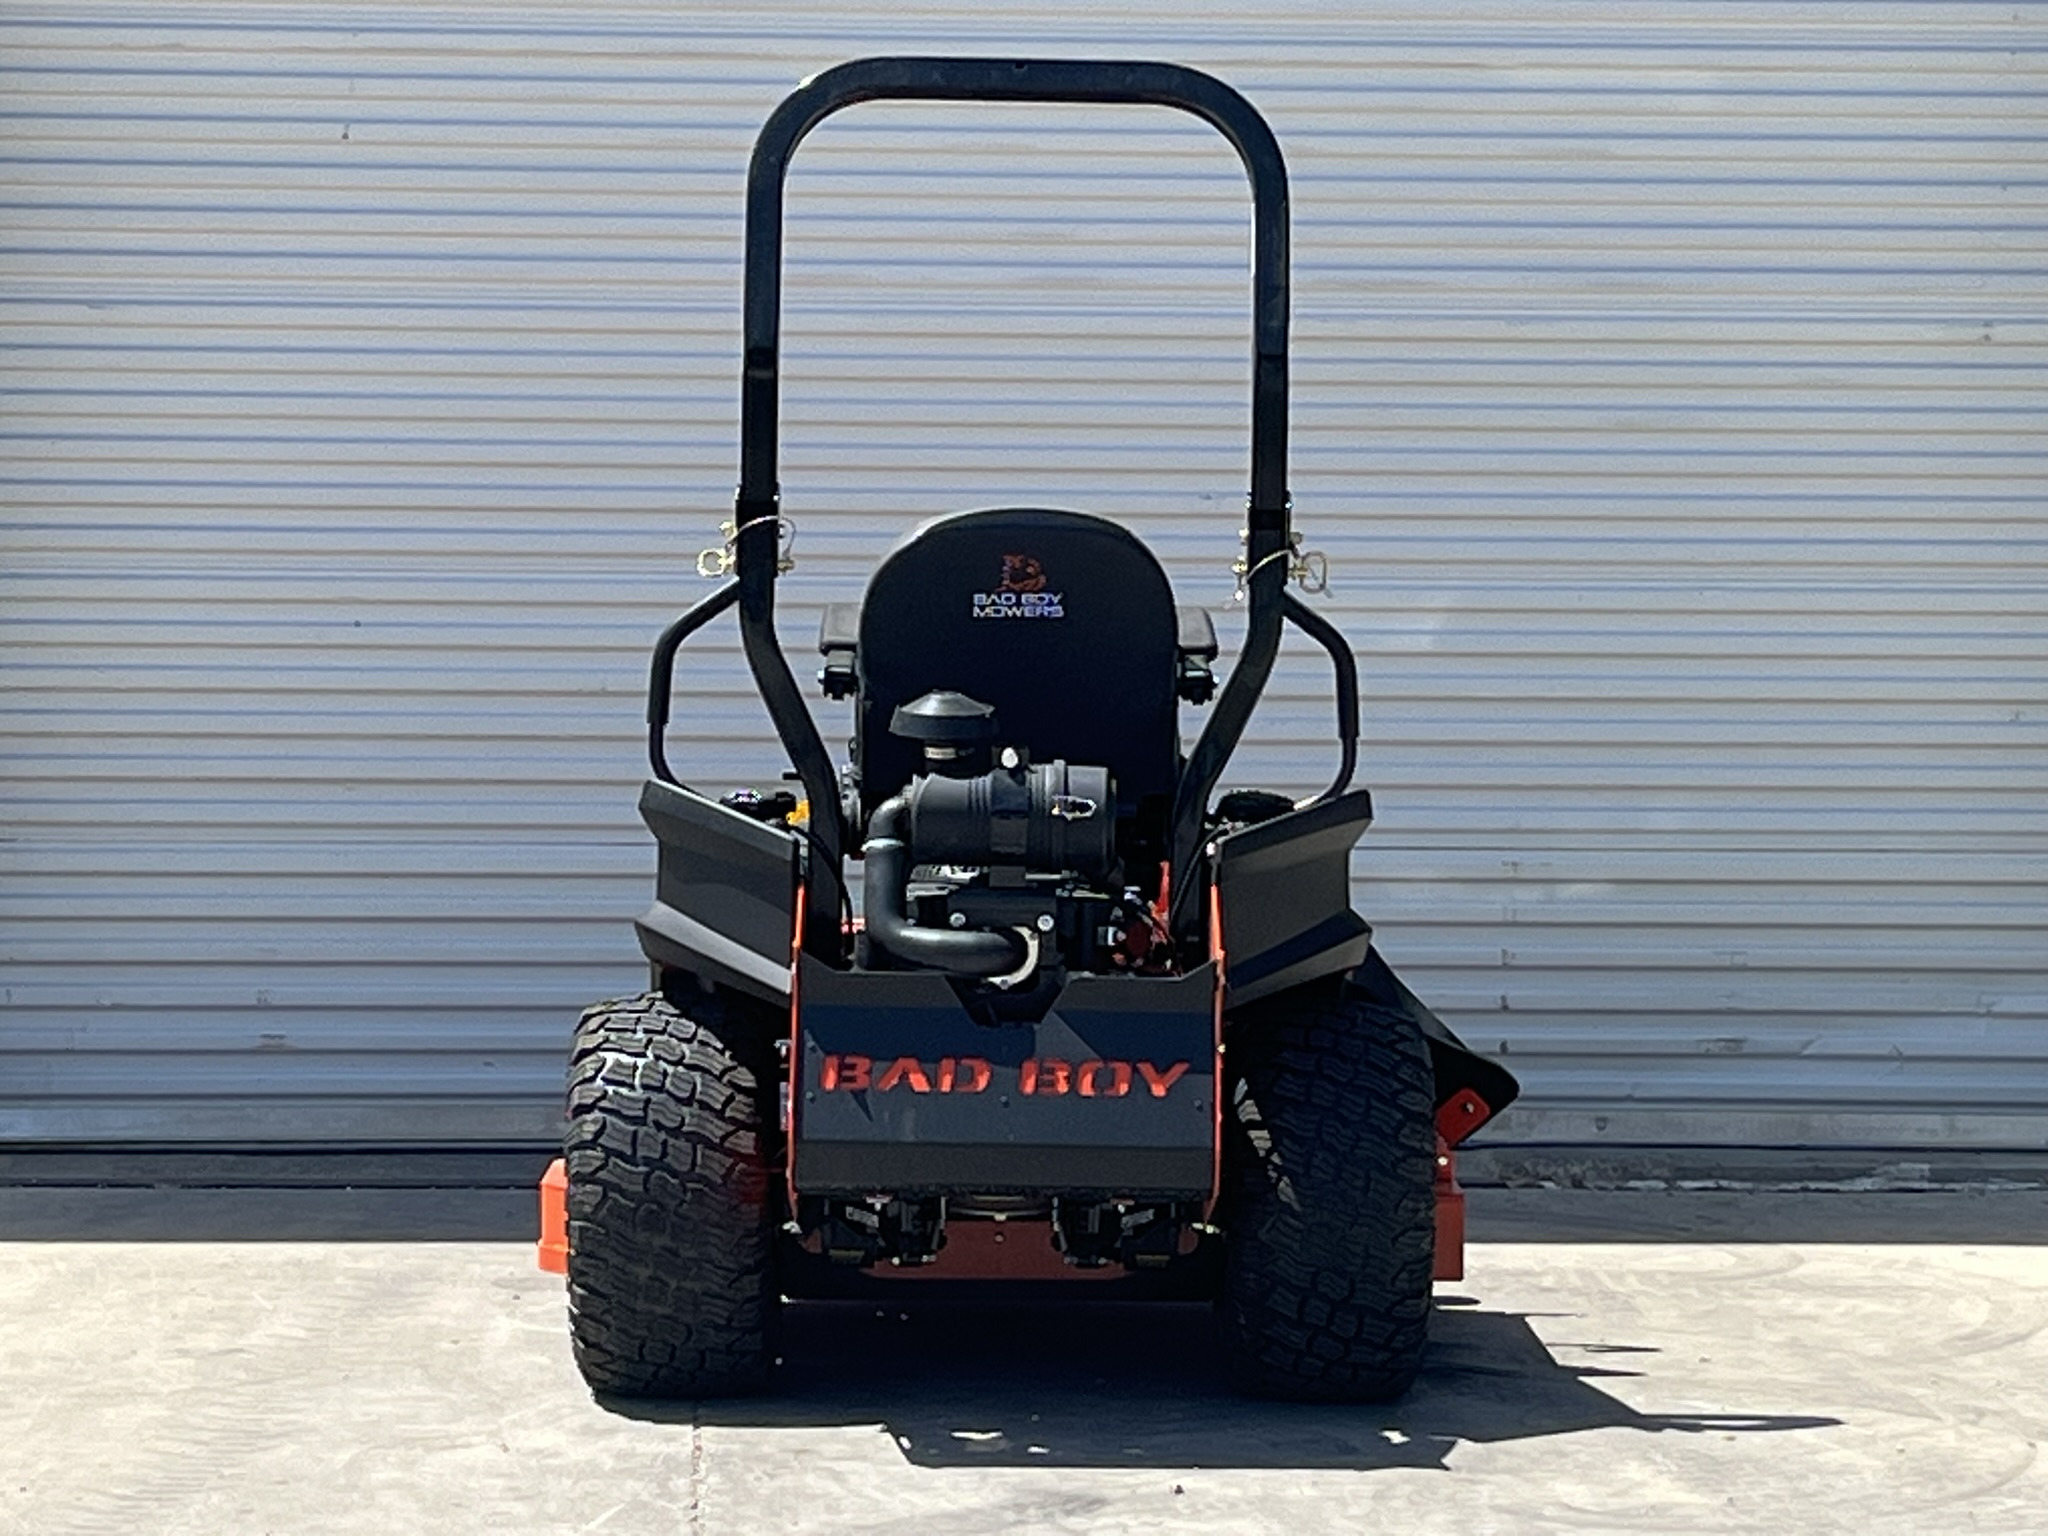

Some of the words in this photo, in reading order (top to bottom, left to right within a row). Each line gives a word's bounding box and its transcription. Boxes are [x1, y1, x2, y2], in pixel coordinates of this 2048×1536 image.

[973, 593, 1017, 605] BAD
[1021, 593, 1063, 605] BOY
[973, 606, 1064, 618] MOWERS
[820, 1055, 993, 1094] BAD
[1019, 1058, 1189, 1098] BOY
